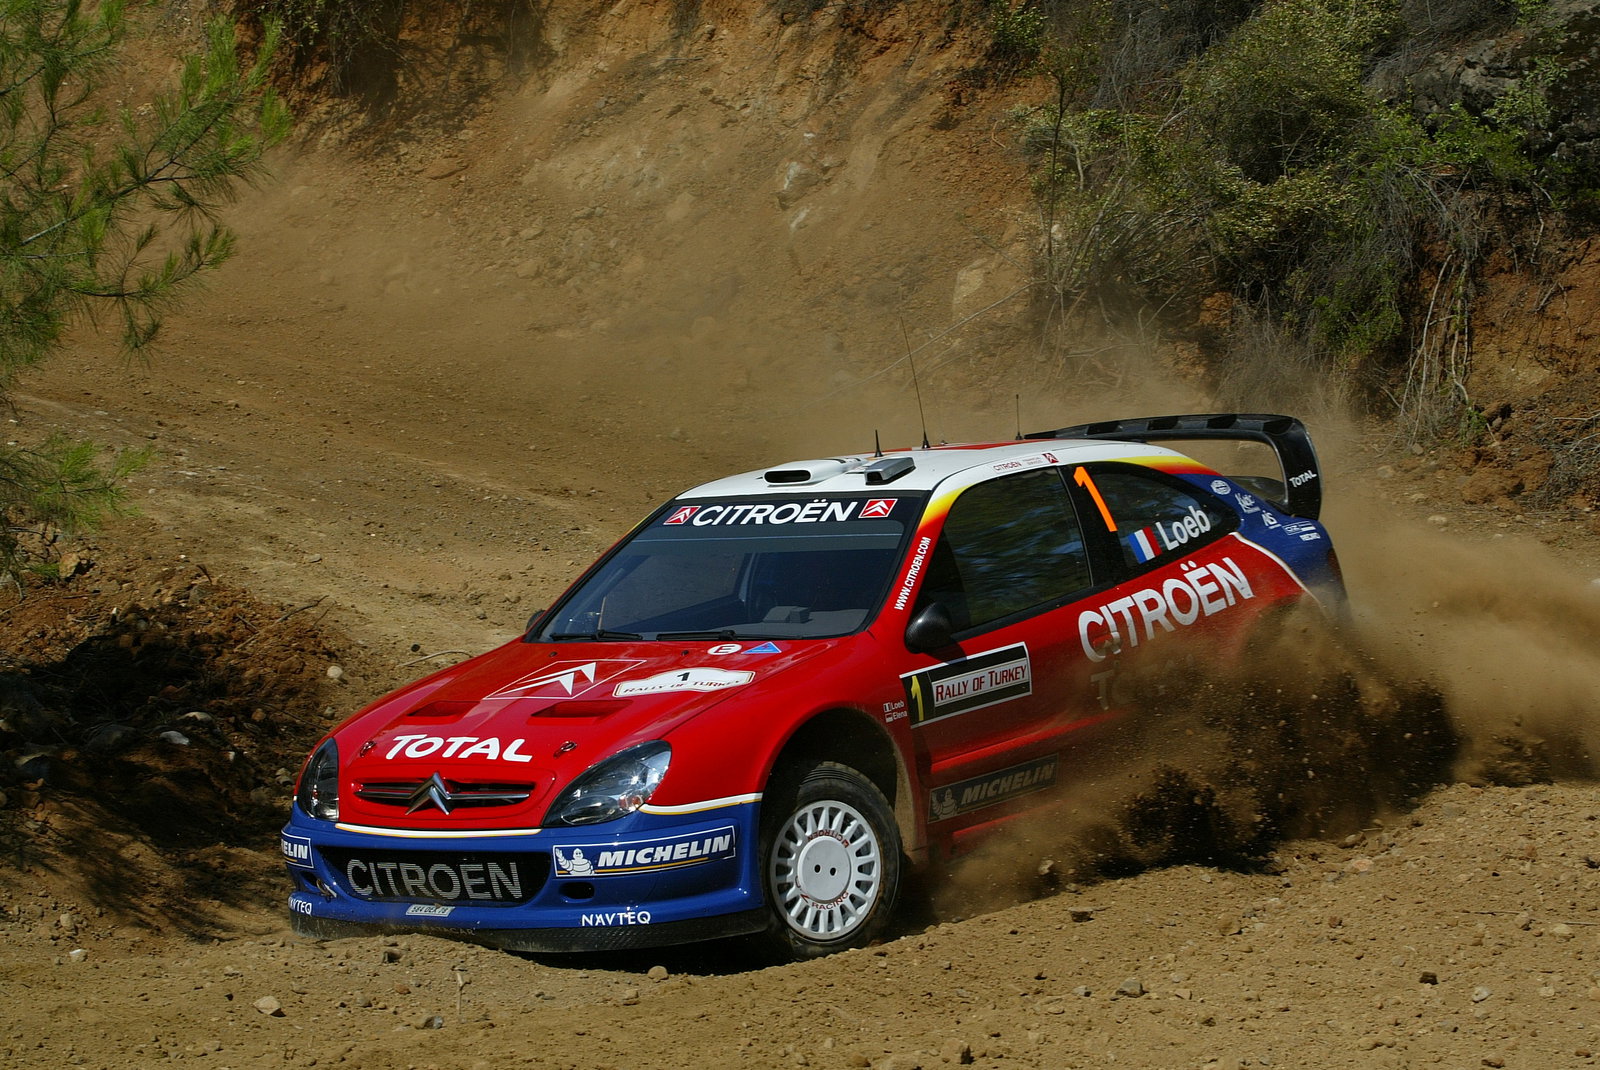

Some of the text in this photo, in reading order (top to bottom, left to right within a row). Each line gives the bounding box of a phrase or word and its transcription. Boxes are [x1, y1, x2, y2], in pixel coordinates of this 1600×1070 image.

[1289, 470, 1317, 488] TOTAL
[692, 499, 858, 526] CITROËN
[1073, 466, 1118, 532] 1
[1156, 505, 1212, 551] Loeb
[894, 536, 932, 611] WWW.CITROEN.COM
[1077, 556, 1256, 663] CITROËN
[623, 685, 664, 694] RALLY
[693, 679, 742, 687] TURKEY
[677, 672, 690, 682] 1
[891, 700, 905, 710] Loeb
[910, 675, 925, 722] 1
[385, 734, 533, 763] TOTAL
[961, 762, 1055, 805] MICHELIN
[597, 834, 731, 868] MICHELIN
[581, 910, 651, 927] NAVTEQ
